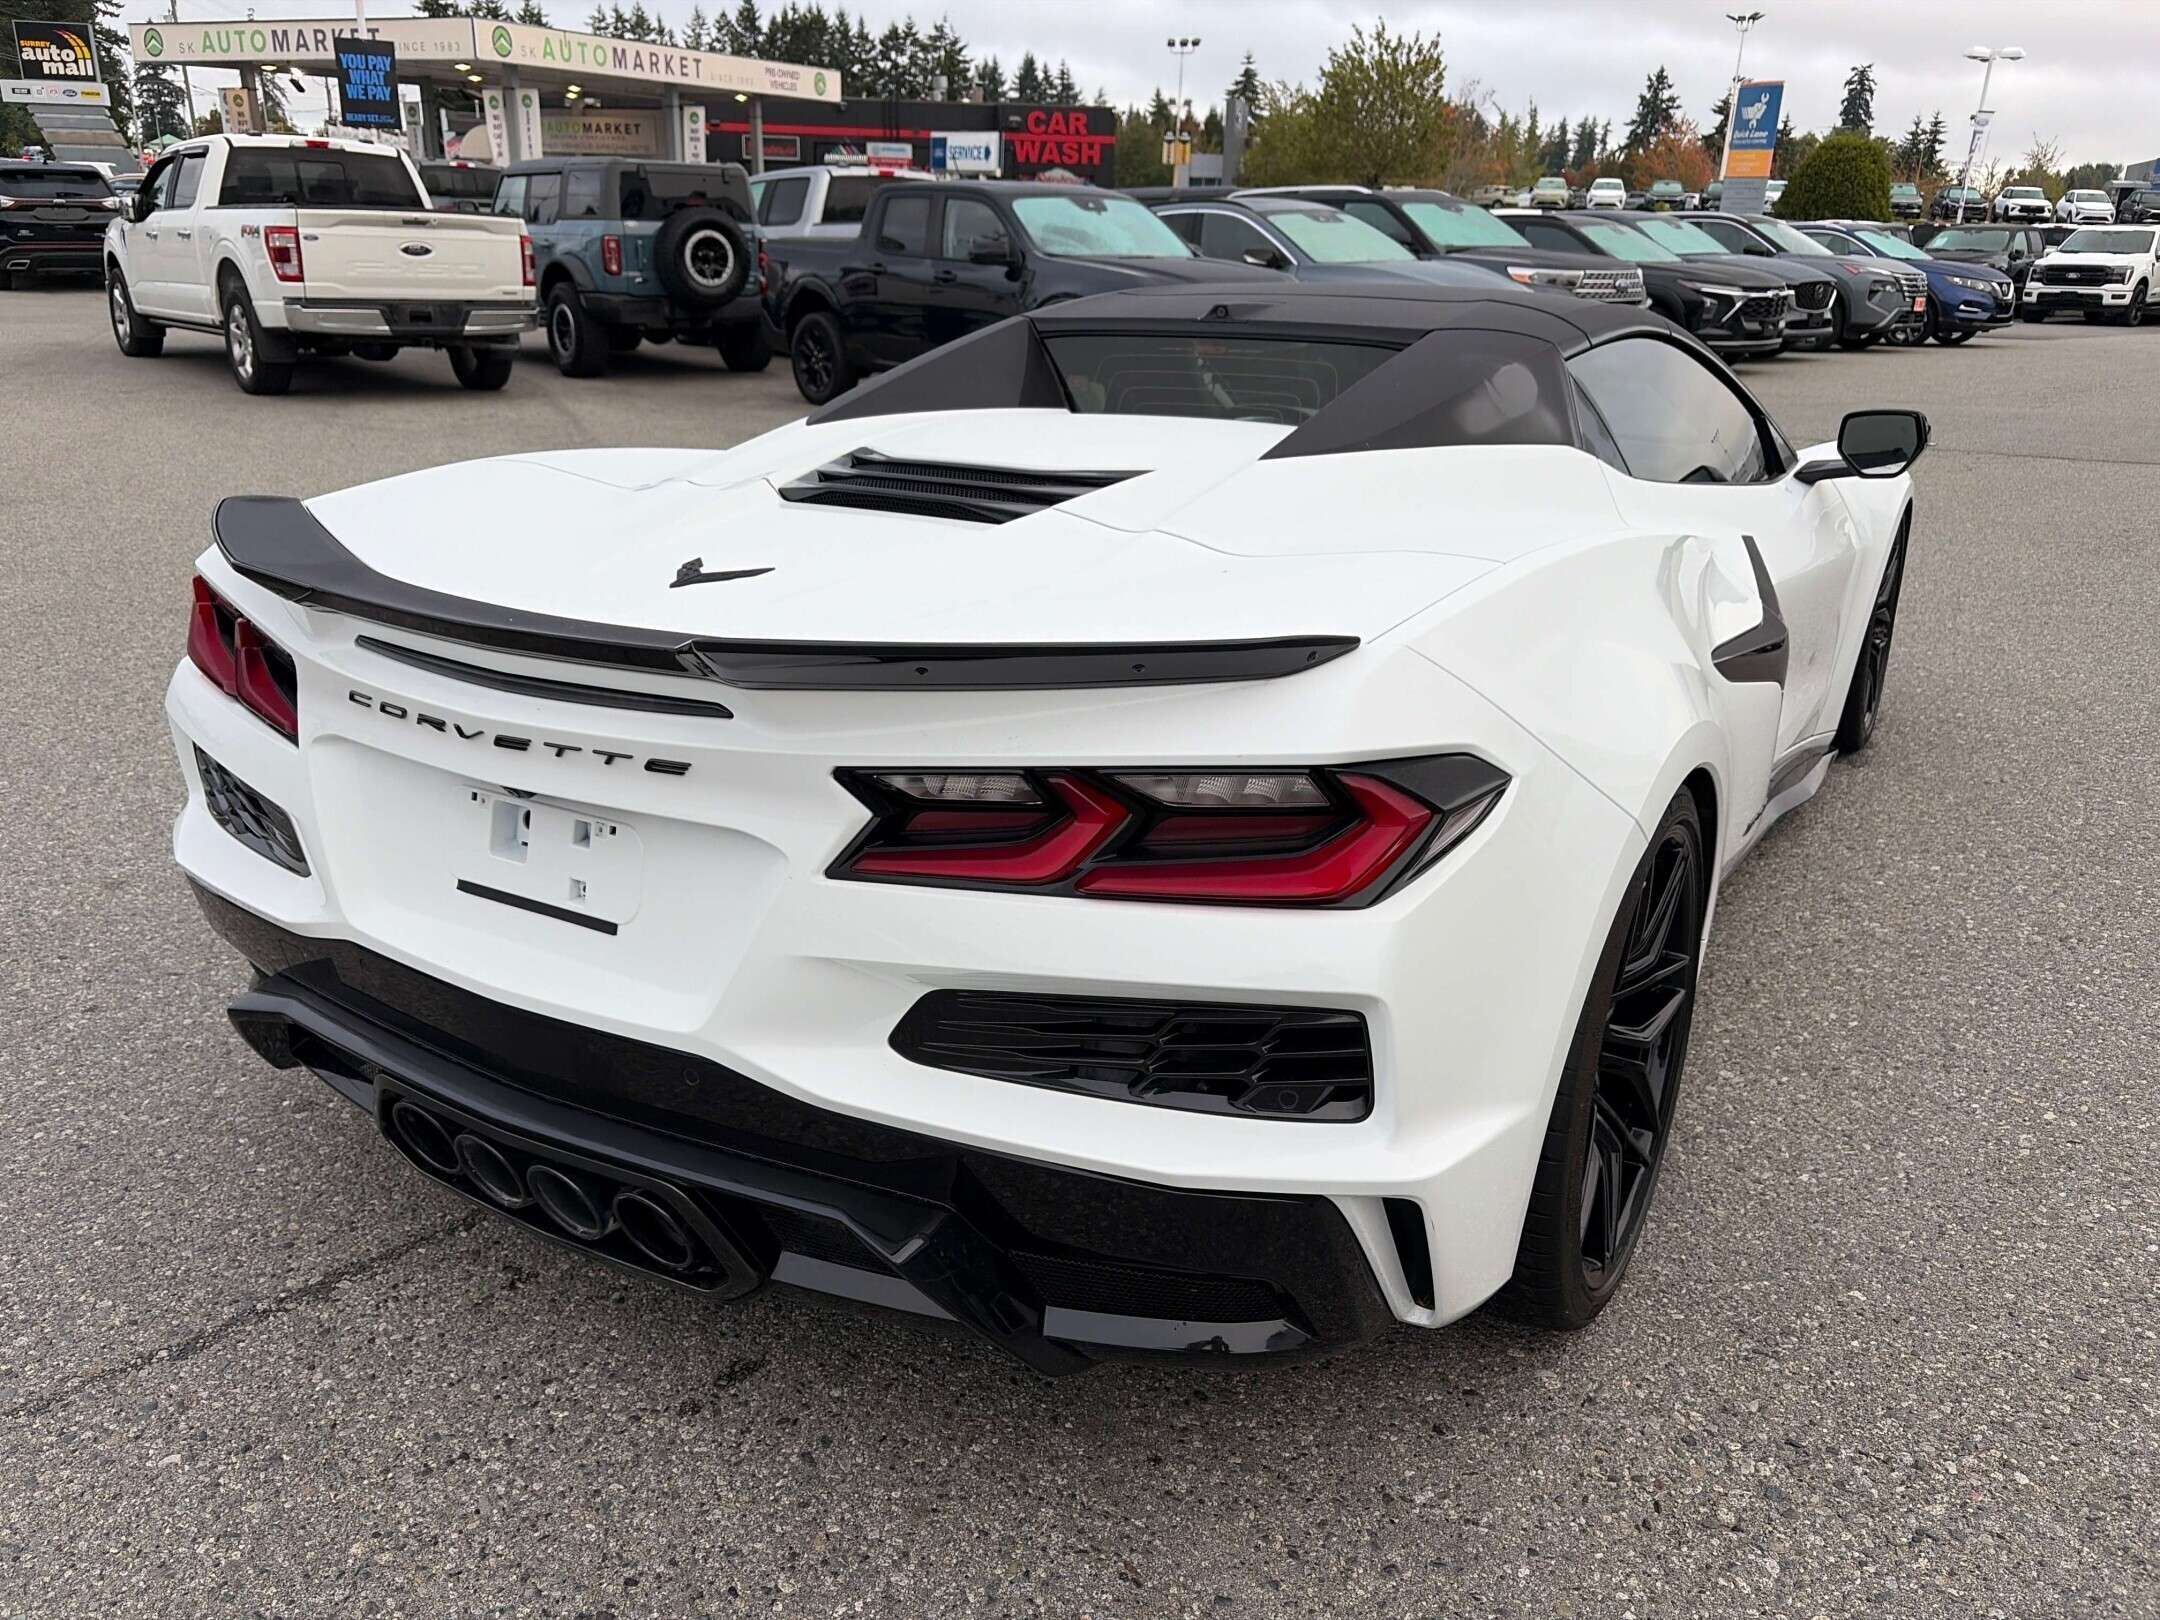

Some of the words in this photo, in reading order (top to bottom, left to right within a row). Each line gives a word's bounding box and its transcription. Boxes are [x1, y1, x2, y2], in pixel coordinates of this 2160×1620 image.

[20, 40, 50, 48] SURREY
[21, 44, 76, 61] auto
[179, 41, 195, 54] SK
[434, 42, 461, 52] 1983
[520, 45, 537, 58] SK
[42, 59, 94, 76] mall
[340, 53, 366, 69] YOU
[368, 55, 391, 71] PAY
[349, 69, 385, 85] WHAT
[345, 83, 367, 100] WE
[368, 85, 391, 101] PAY
[1027, 111, 1088, 136] CAR
[949, 145, 982, 160] SERVICE
[1014, 140, 1102, 165] WASH
[349, 689, 692, 776] CORVETTE
